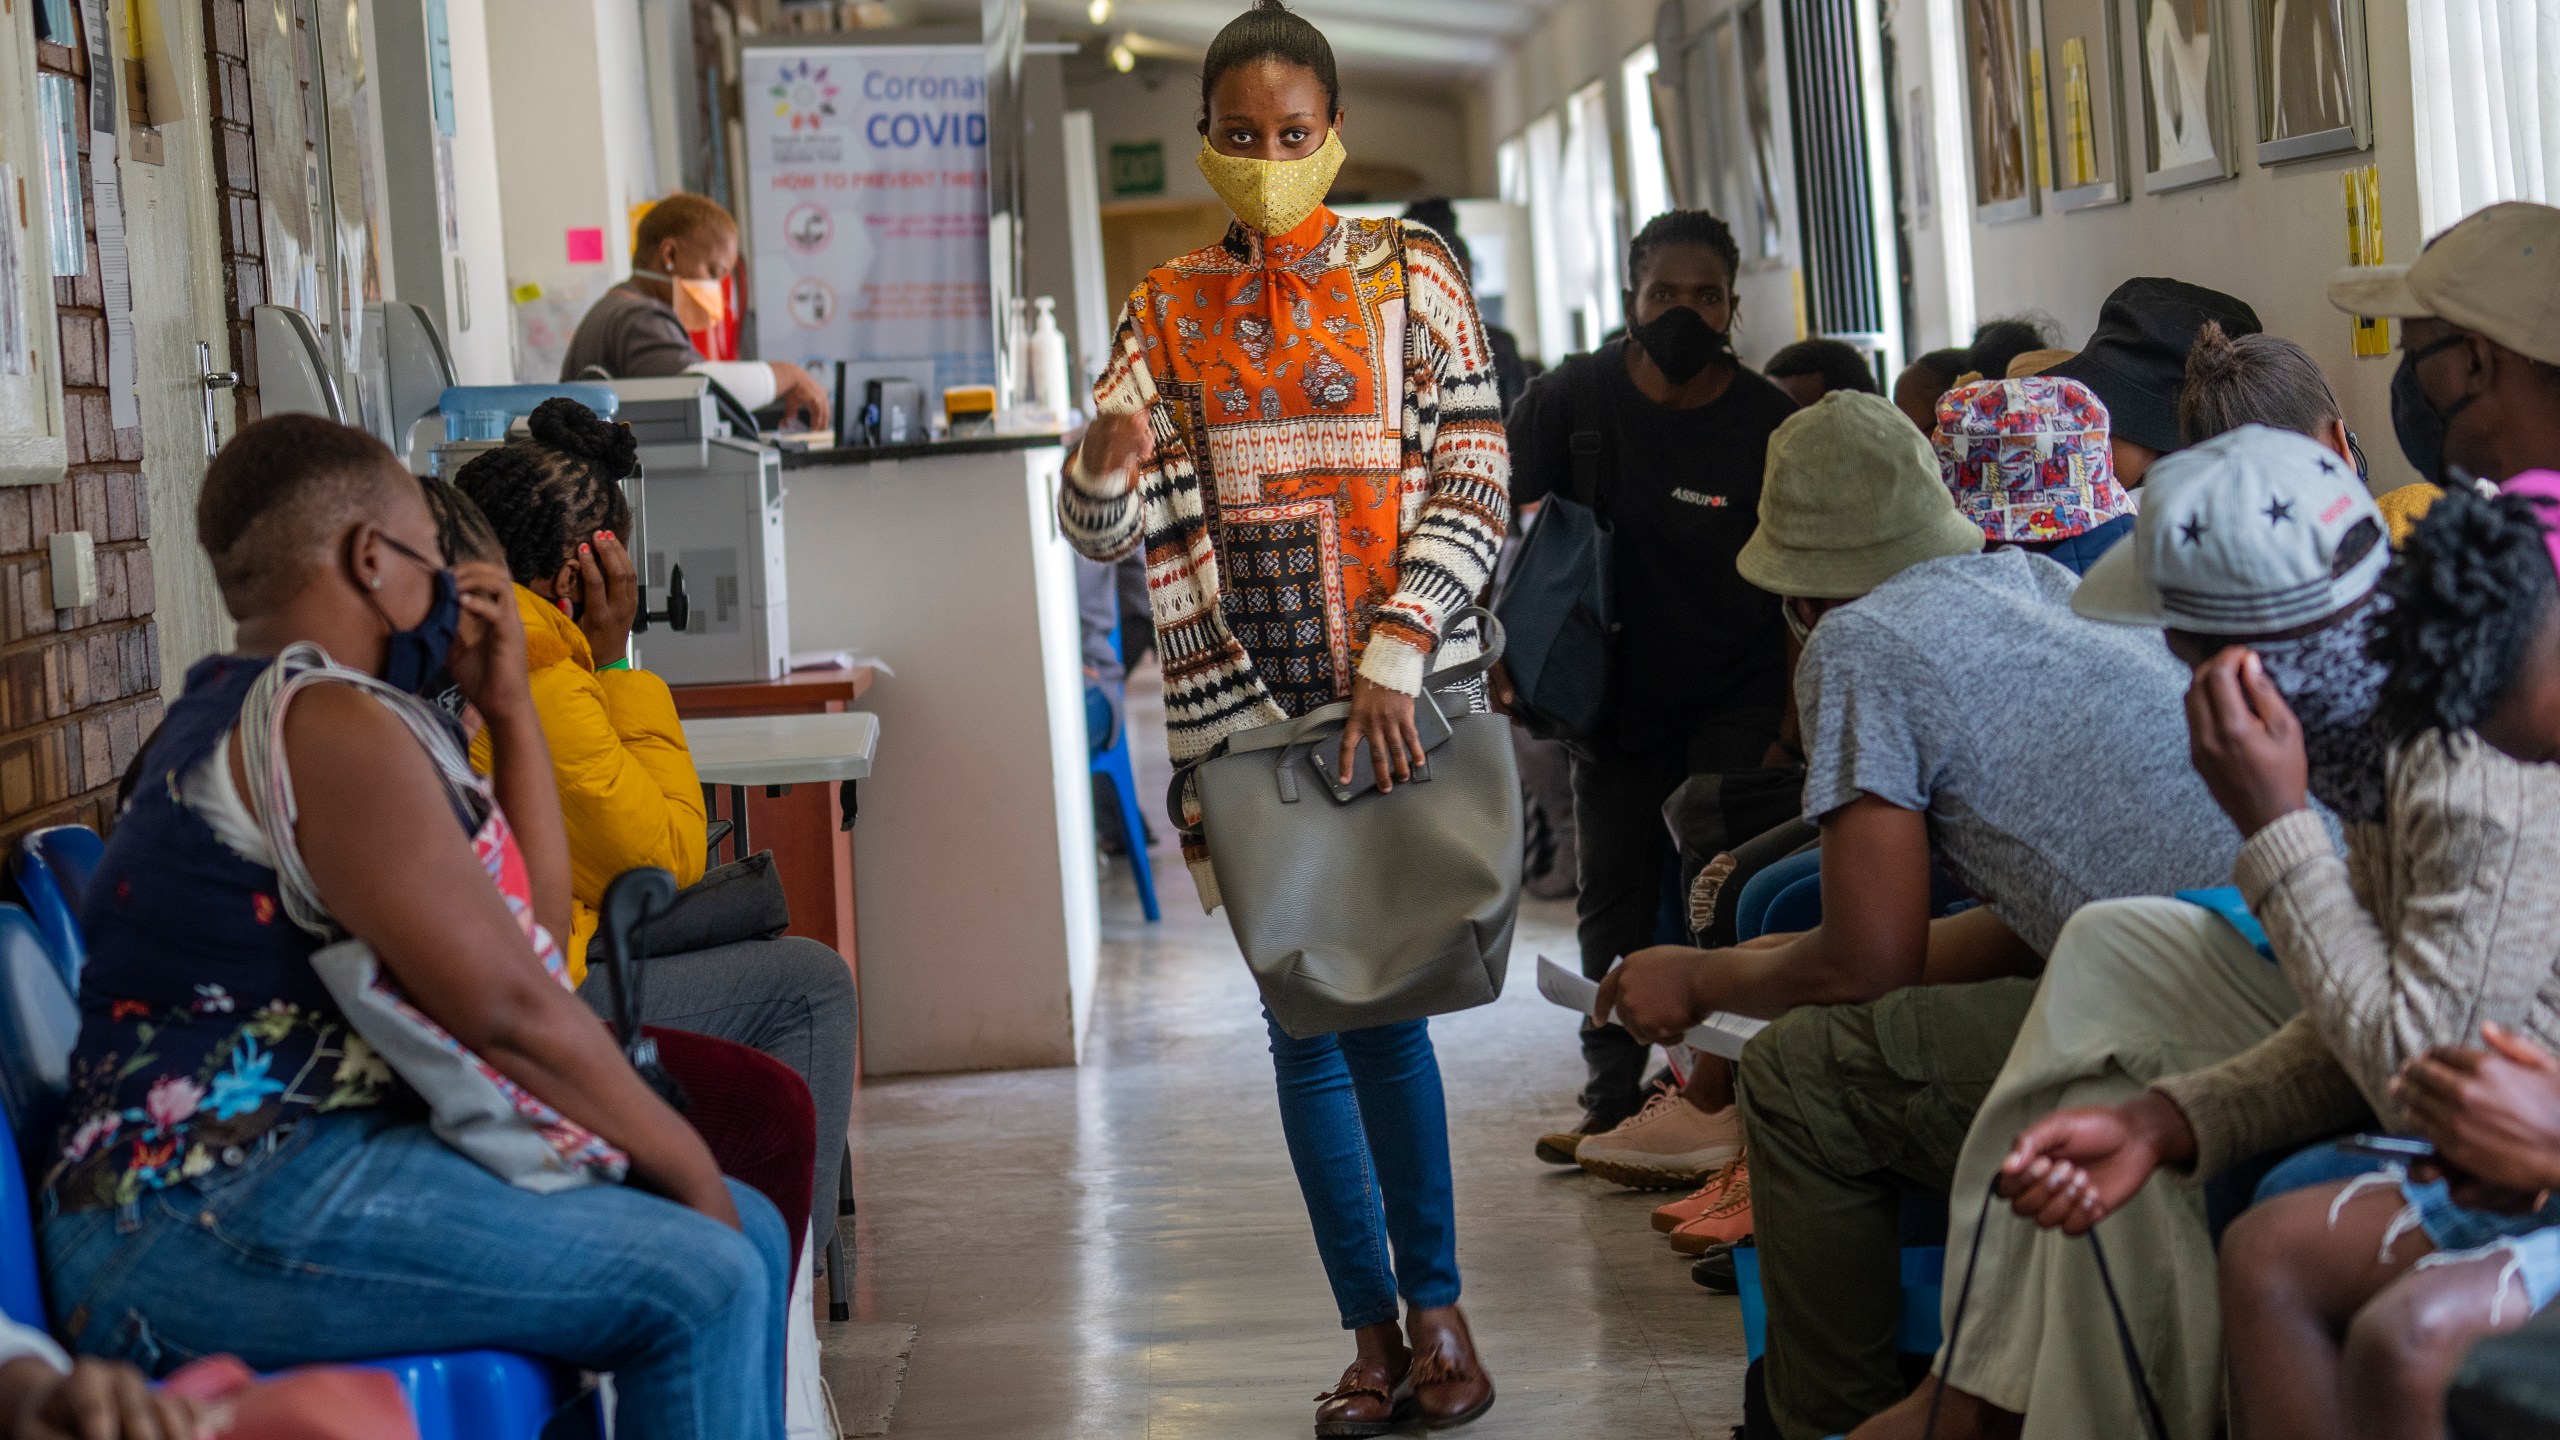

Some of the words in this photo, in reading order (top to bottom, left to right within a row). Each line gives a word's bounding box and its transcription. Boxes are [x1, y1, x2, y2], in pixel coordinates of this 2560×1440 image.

[866, 112, 987, 148] COVID
[771, 172, 816, 190] HOW
[823, 171, 848, 190] TO
[852, 170, 935, 189] PREVENT
[1671, 487, 1728, 506] ASSUPOL
